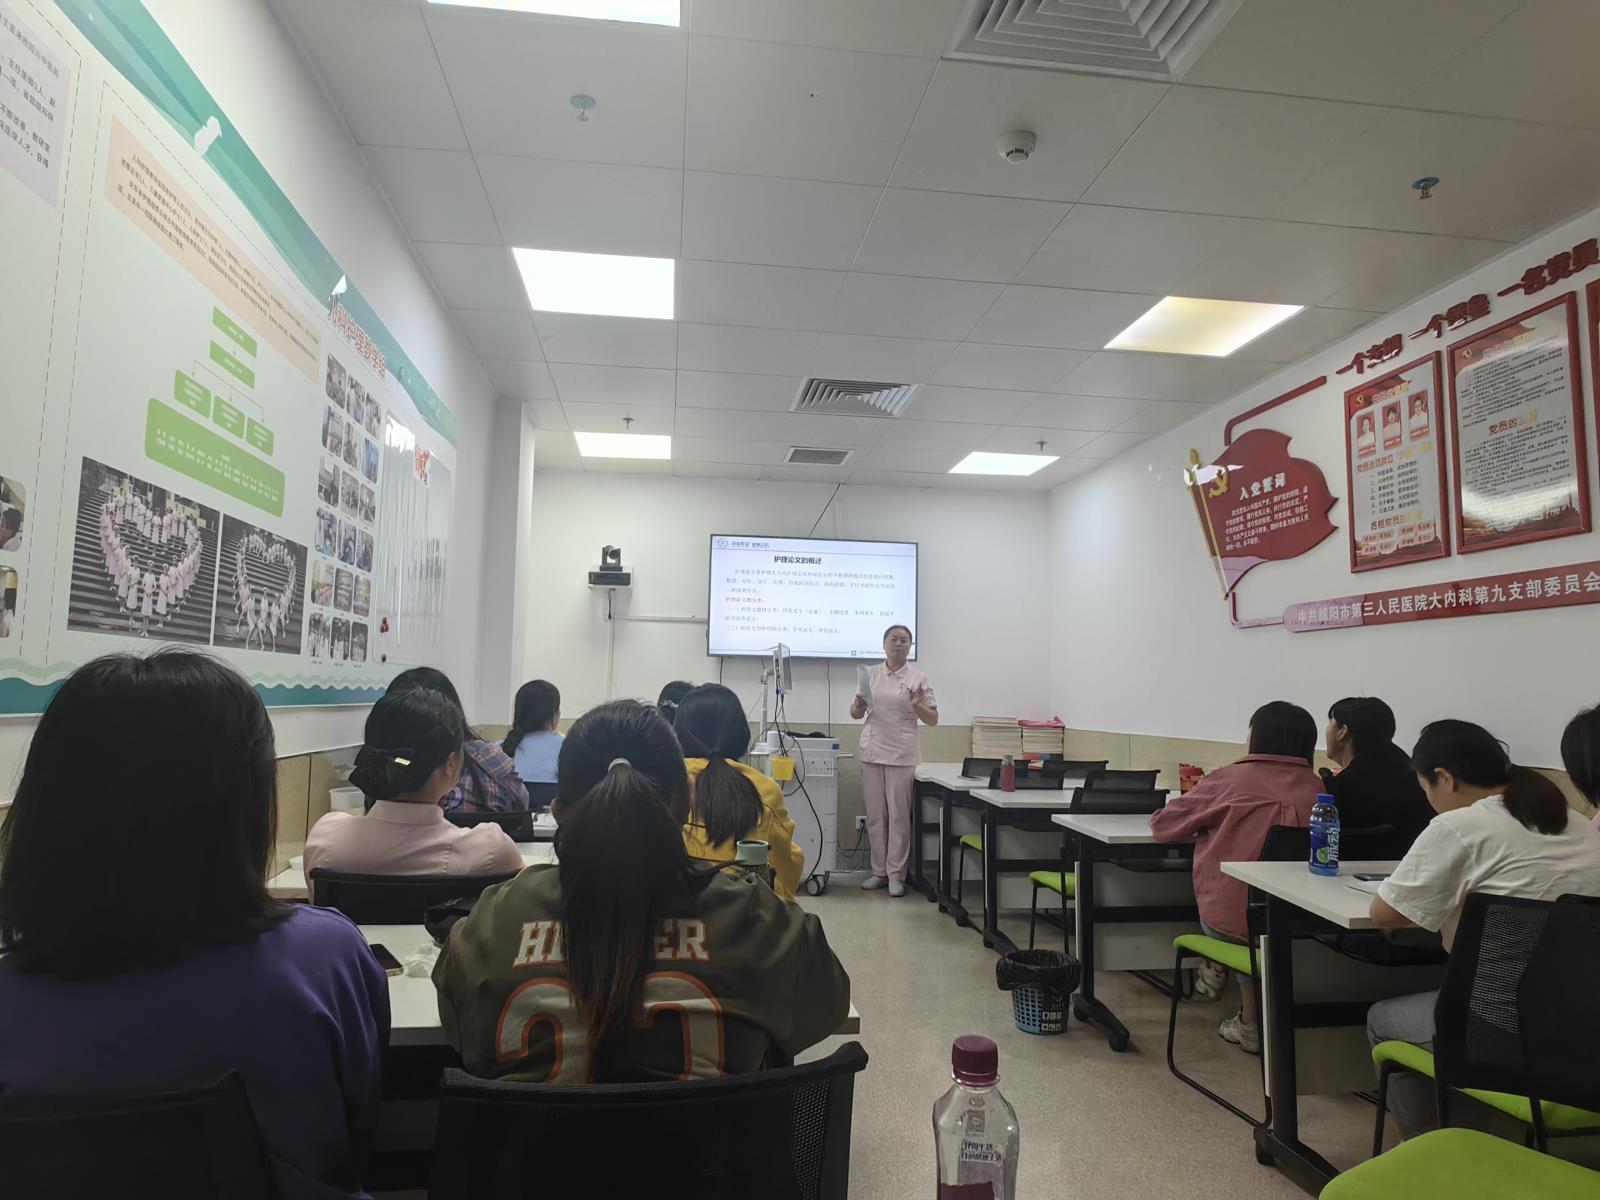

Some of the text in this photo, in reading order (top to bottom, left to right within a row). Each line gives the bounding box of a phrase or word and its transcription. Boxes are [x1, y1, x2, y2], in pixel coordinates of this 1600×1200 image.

[1240, 472, 1287, 501] 入党誓词
[773, 555, 822, 565] 护理论文的概述
[1297, 570, 1600, 625] 中共绵阳市第三人民医院大内科第九支部委员会
